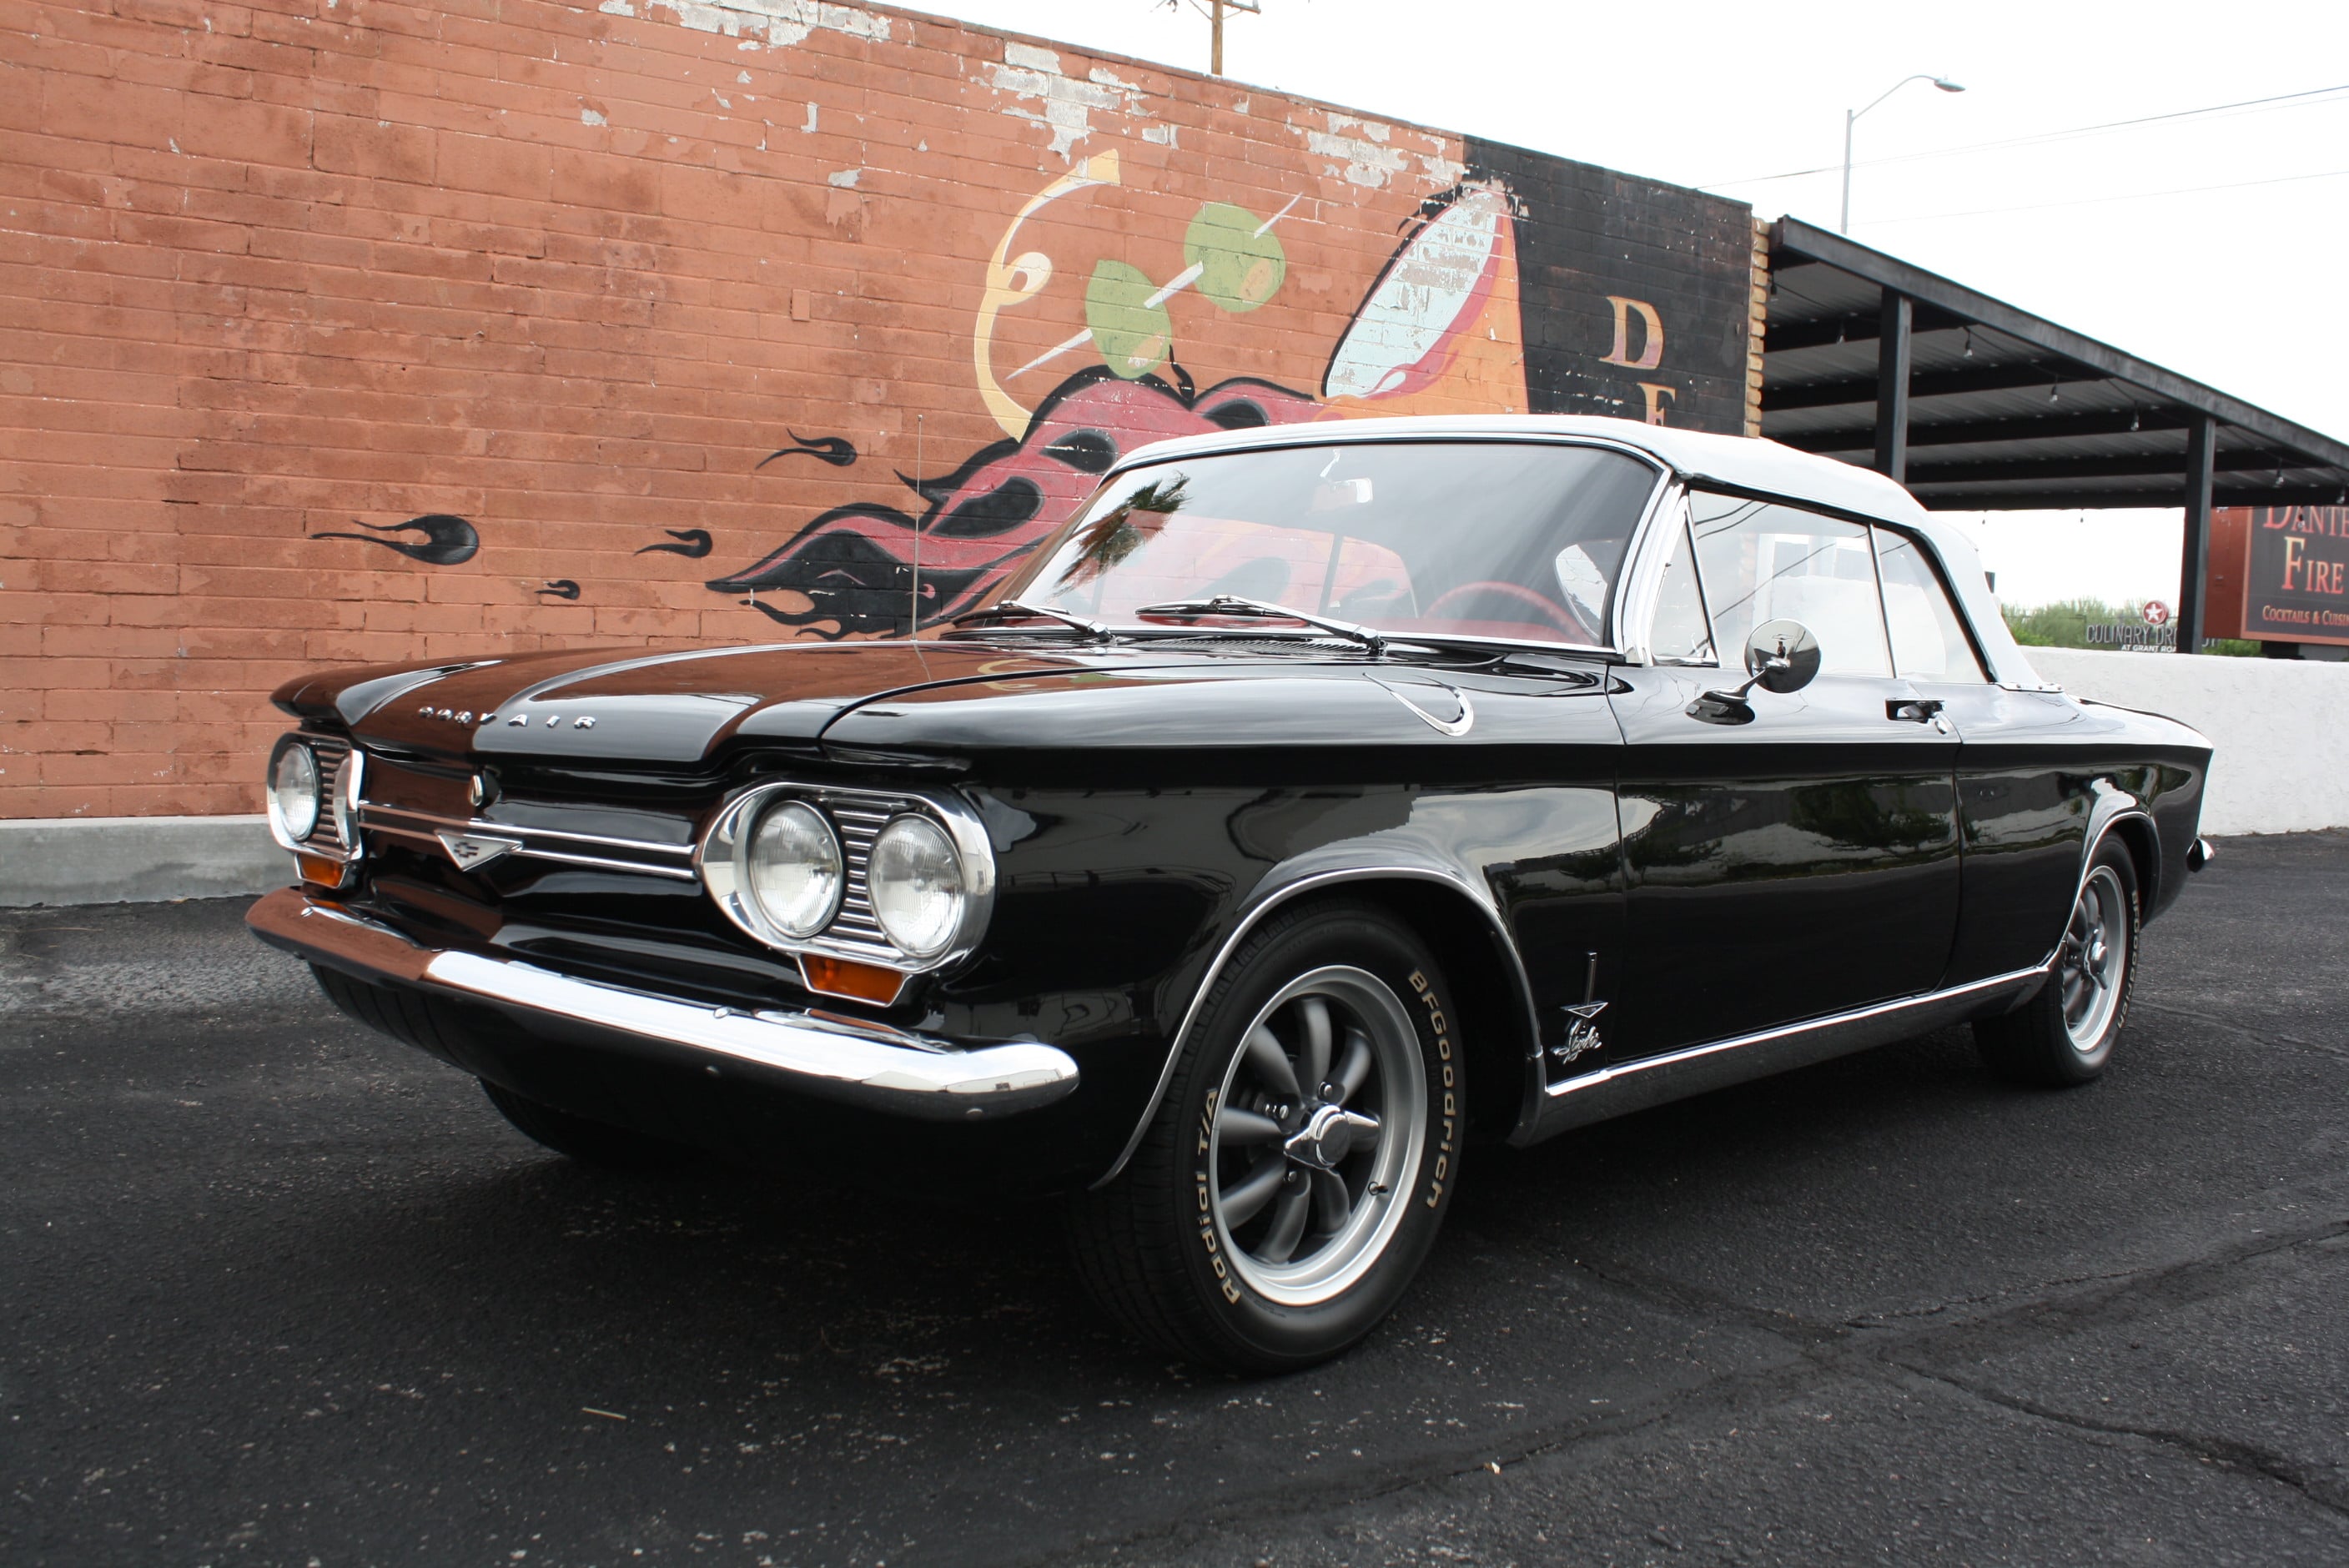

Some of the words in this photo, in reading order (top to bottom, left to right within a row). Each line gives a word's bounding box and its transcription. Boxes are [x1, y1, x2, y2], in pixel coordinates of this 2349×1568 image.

[1599, 295, 1664, 370] D
[2281, 535, 2345, 595] FIRE
[2086, 625, 2150, 645] CULINARY
[2262, 605, 2311, 624] COCKTAILS
[2313, 611, 2321, 625] &
[2132, 645, 2160, 653] GRANT
[2160, 645, 2177, 653] ROA
[1408, 969, 1456, 1209] BFGoodrich
[1198, 1088, 1219, 1156] T/A
[1196, 1171, 1241, 1305] Radial
